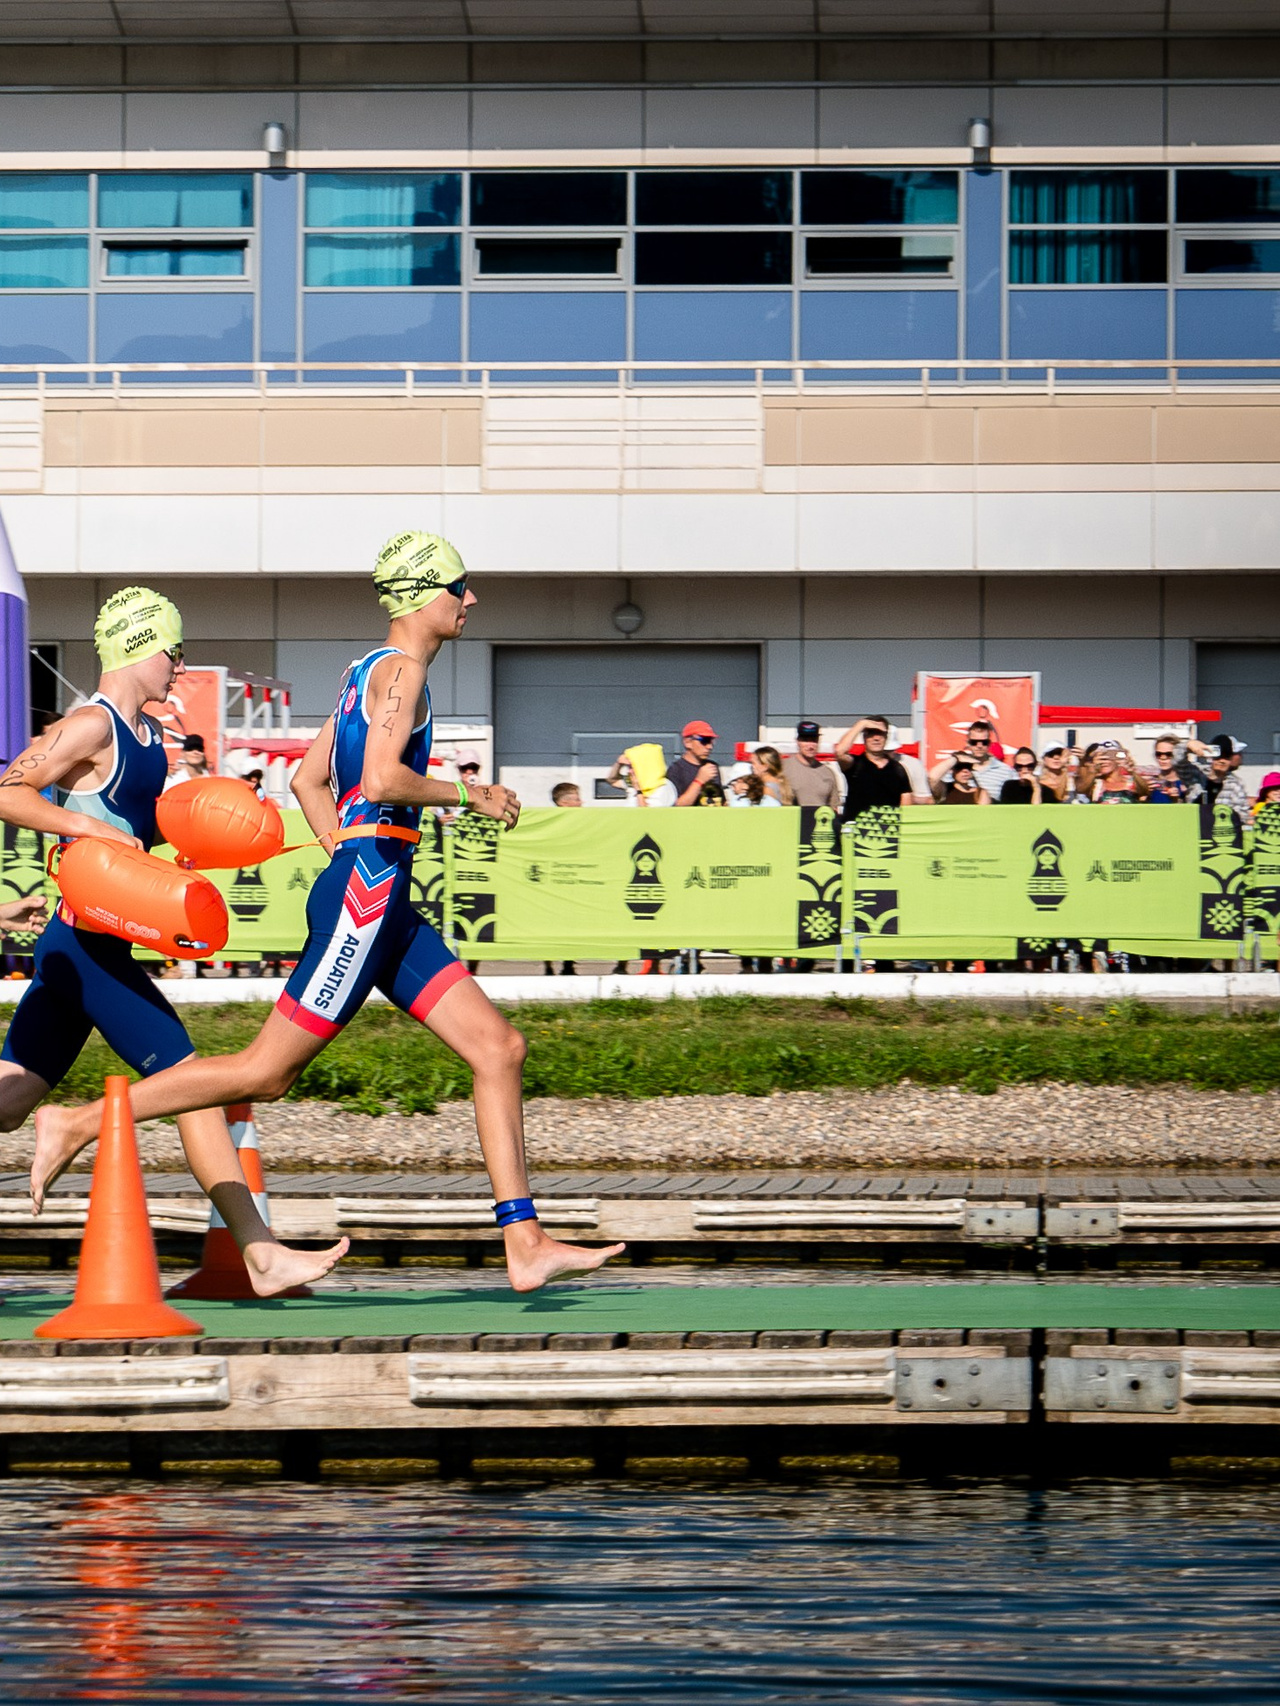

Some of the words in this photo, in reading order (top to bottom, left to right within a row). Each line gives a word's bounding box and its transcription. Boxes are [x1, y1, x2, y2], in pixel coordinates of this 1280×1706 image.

[124, 633, 157, 653] WAVE
[126, 628, 153, 645] MAD
[314, 933, 360, 1010] AQUATICS
